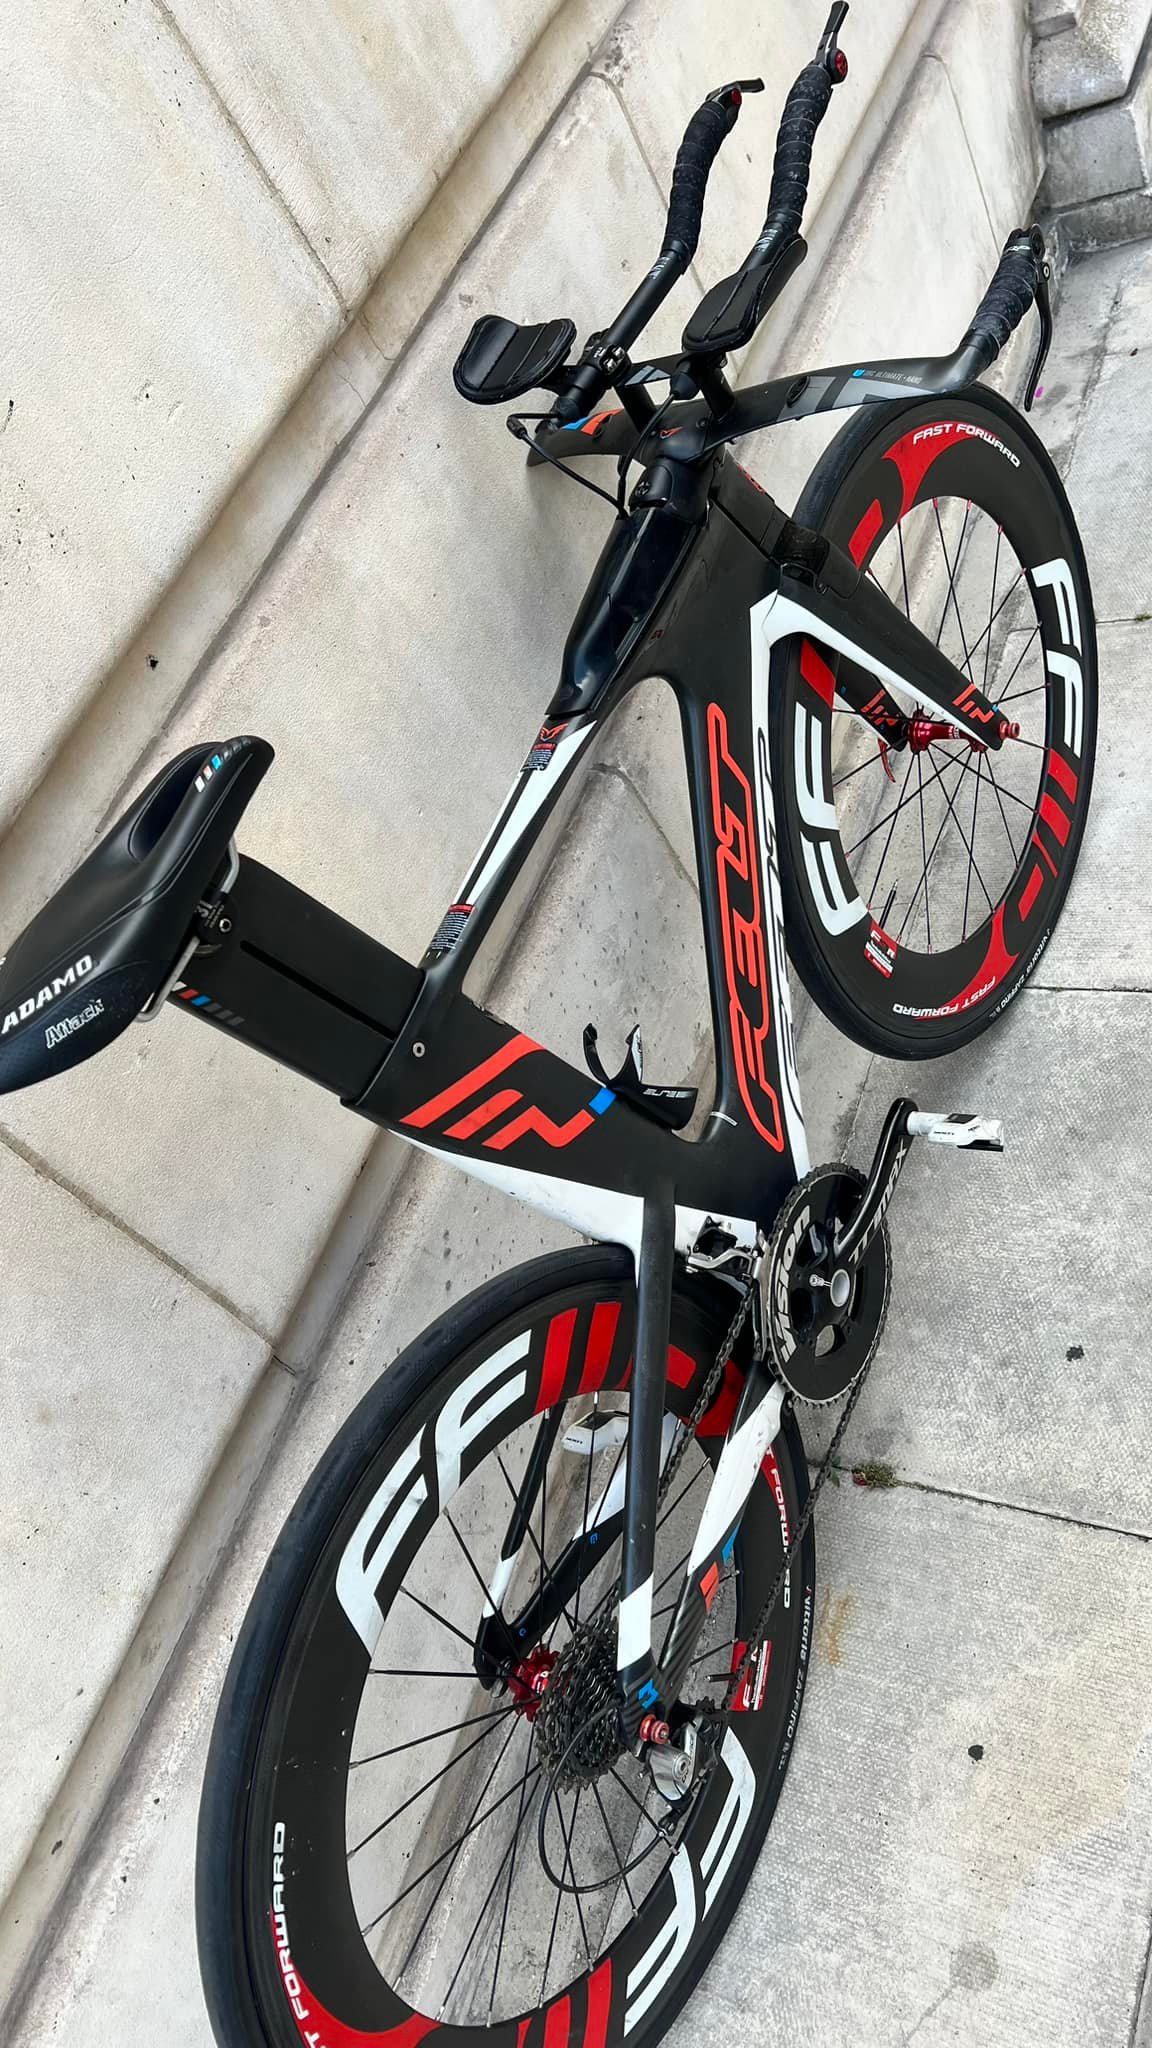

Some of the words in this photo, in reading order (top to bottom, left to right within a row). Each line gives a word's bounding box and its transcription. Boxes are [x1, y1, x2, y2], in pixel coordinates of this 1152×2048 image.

[913, 423, 953, 445] FAST
[956, 423, 1021, 468] FORWARD
[1, 954, 94, 1035] ADAMO
[892, 1002, 959, 1019] FORWARD
[962, 976, 997, 1009] FAST
[44, 998, 105, 1049] Attack
[774, 1467, 792, 1609] FORWRD
[272, 1821, 310, 2021] FORWARD
